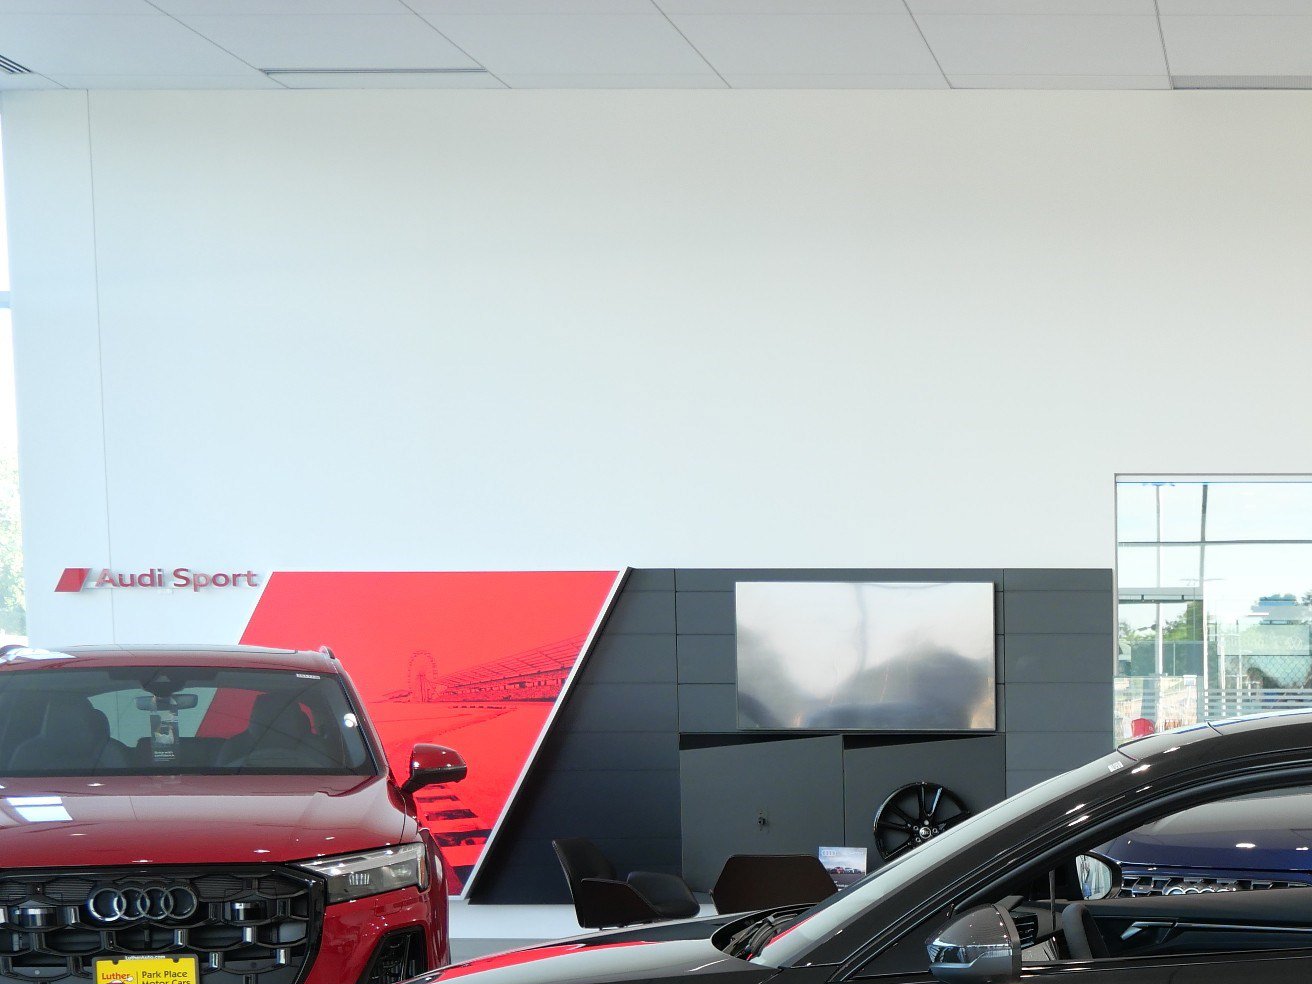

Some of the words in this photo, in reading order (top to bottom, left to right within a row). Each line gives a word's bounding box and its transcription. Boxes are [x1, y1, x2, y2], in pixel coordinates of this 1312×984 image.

[96, 568, 165, 587] Audi
[173, 568, 258, 592] Sport
[101, 972, 131, 980] Luther
[141, 970, 161, 979] Park
[163, 970, 188, 978] Place
